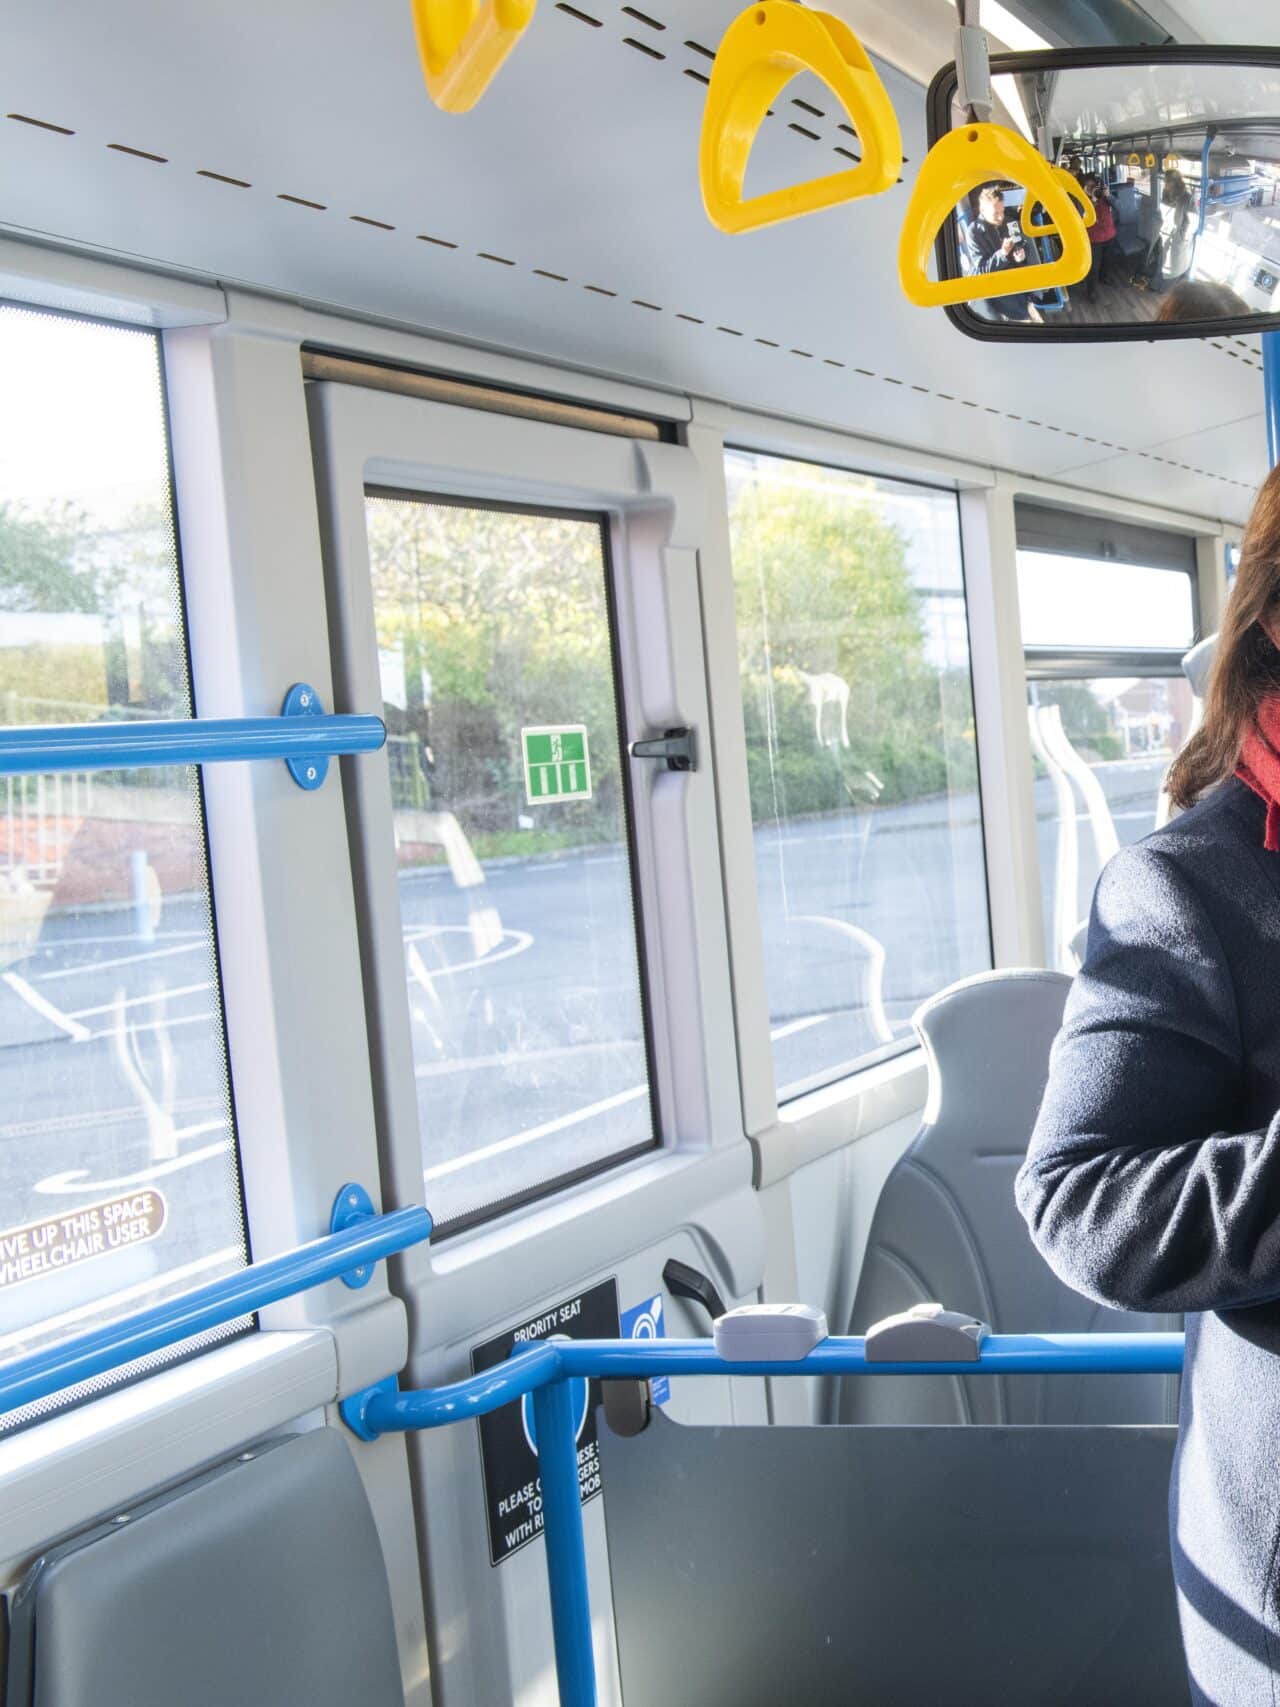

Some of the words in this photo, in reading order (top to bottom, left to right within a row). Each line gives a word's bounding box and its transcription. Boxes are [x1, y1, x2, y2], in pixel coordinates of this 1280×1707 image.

[0, 1233, 29, 1260] IVE
[32, 1224, 58, 1249] UP
[61, 1210, 100, 1239] THIS
[103, 1194, 153, 1226] SPACE
[107, 1217, 151, 1247] USER
[514, 1311, 558, 1342] PRIORITY
[560, 1299, 582, 1323] SEAT
[498, 1482, 535, 1517] PLEASE
[527, 1496, 543, 1515] TO
[505, 1519, 533, 1548] WITH
